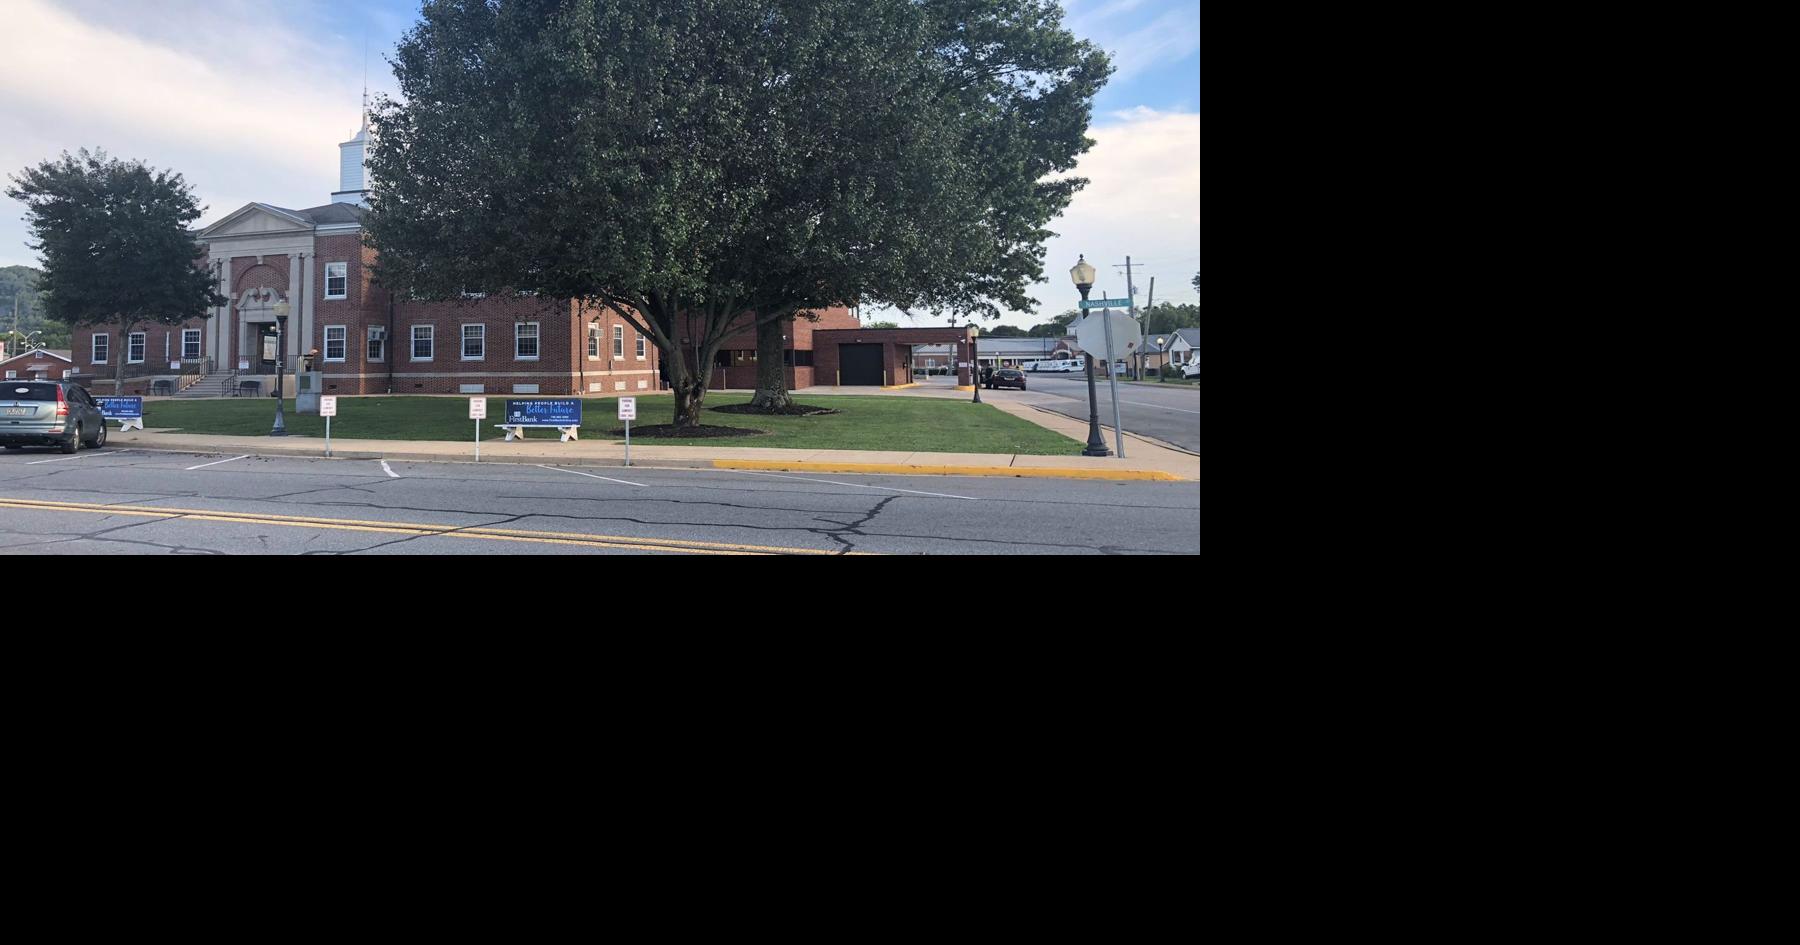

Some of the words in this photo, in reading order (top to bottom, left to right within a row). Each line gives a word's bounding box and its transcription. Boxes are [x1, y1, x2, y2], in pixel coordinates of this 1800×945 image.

[1086, 300, 1122, 308] NASHVILLE
[526, 404, 547, 414] Better
[549, 404, 574, 414] Future
[508, 415, 538, 423] FirstBank
